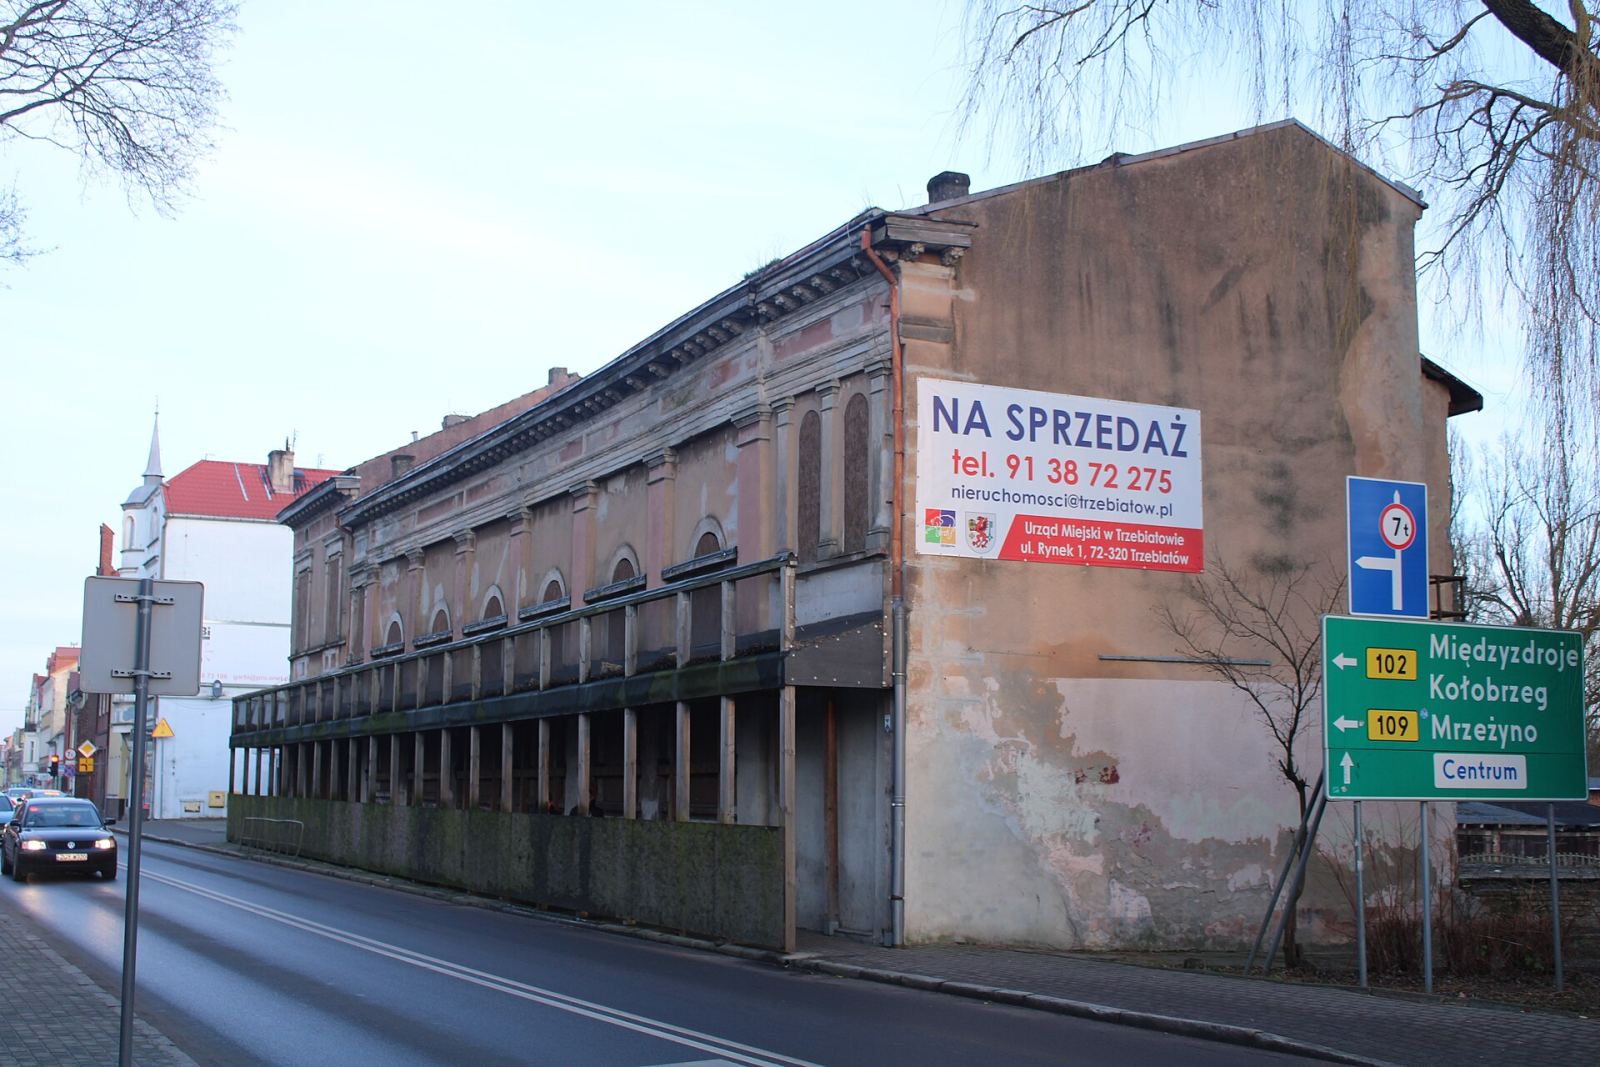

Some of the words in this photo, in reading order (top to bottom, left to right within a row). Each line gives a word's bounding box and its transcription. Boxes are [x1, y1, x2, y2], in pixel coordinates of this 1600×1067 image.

[933, 395, 992, 438] NA
[1005, 403, 1188, 458] SPRZEDAŻ
[952, 448, 995, 478] tel.
[1006, 454, 1034, 481] 91
[1047, 458, 1079, 485] 38
[1088, 462, 1118, 489] 72
[1127, 466, 1172, 494] 275
[951, 485, 1173, 519] nieruchomosci@trzebiatow.pl
[1024, 522, 1058, 539] Urząd
[1061, 523, 1101, 541] Miejski
[1104, 531, 1113, 540] w
[1115, 528, 1185, 546] Trzebiatowie
[1020, 542, 1034, 555] ul.
[1038, 543, 1073, 559] Rynek
[1077, 548, 1087, 559] 1,
[1090, 548, 1128, 561] 72-320
[1130, 549, 1189, 565] Trzebiatów
[1376, 654, 1407, 675] 102
[1429, 633, 1579, 672] Międzyzdroje
[1429, 673, 1548, 711] Kołobrzeg
[1377, 716, 1408, 736] 109
[1431, 713, 1538, 749] Mrzeżyno
[1442, 759, 1518, 781] Centrum
